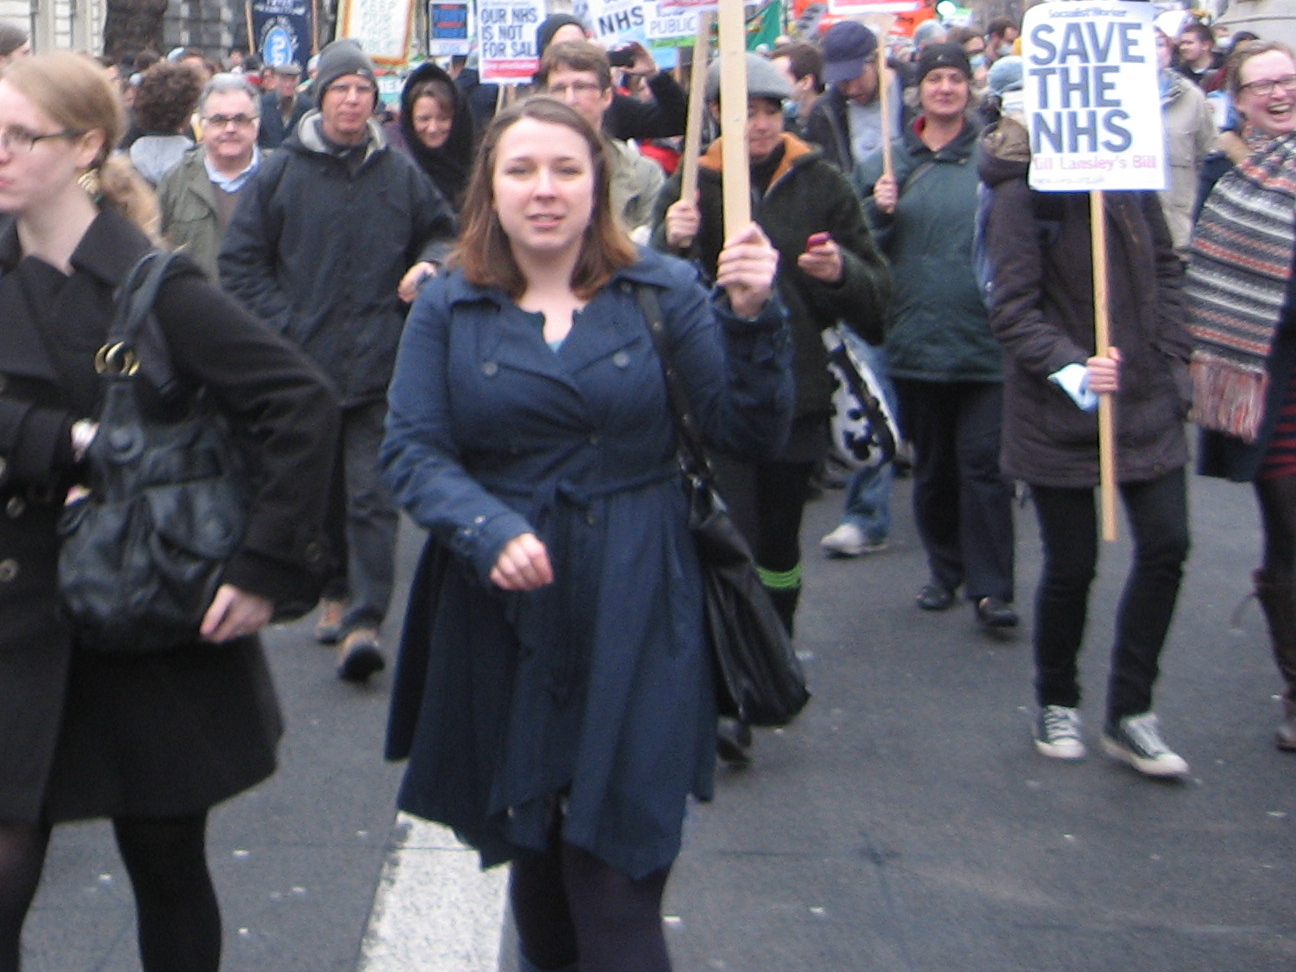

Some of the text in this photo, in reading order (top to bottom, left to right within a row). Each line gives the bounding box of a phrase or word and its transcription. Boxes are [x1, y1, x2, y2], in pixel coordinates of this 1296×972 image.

[481, 8, 506, 23] OUR
[511, 8, 538, 23] NHS
[598, 5, 644, 36] NHS
[482, 24, 523, 40] IS NOT
[650, 16, 697, 35] PUBLIC
[482, 42, 506, 58] FOR
[1029, 21, 1146, 65] SAVE
[1027, 65, 1122, 109] THE
[1031, 109, 1133, 153] NHS
[1060, 156, 1127, 171] Lansley's
[1132, 155, 1157, 169] Bill
